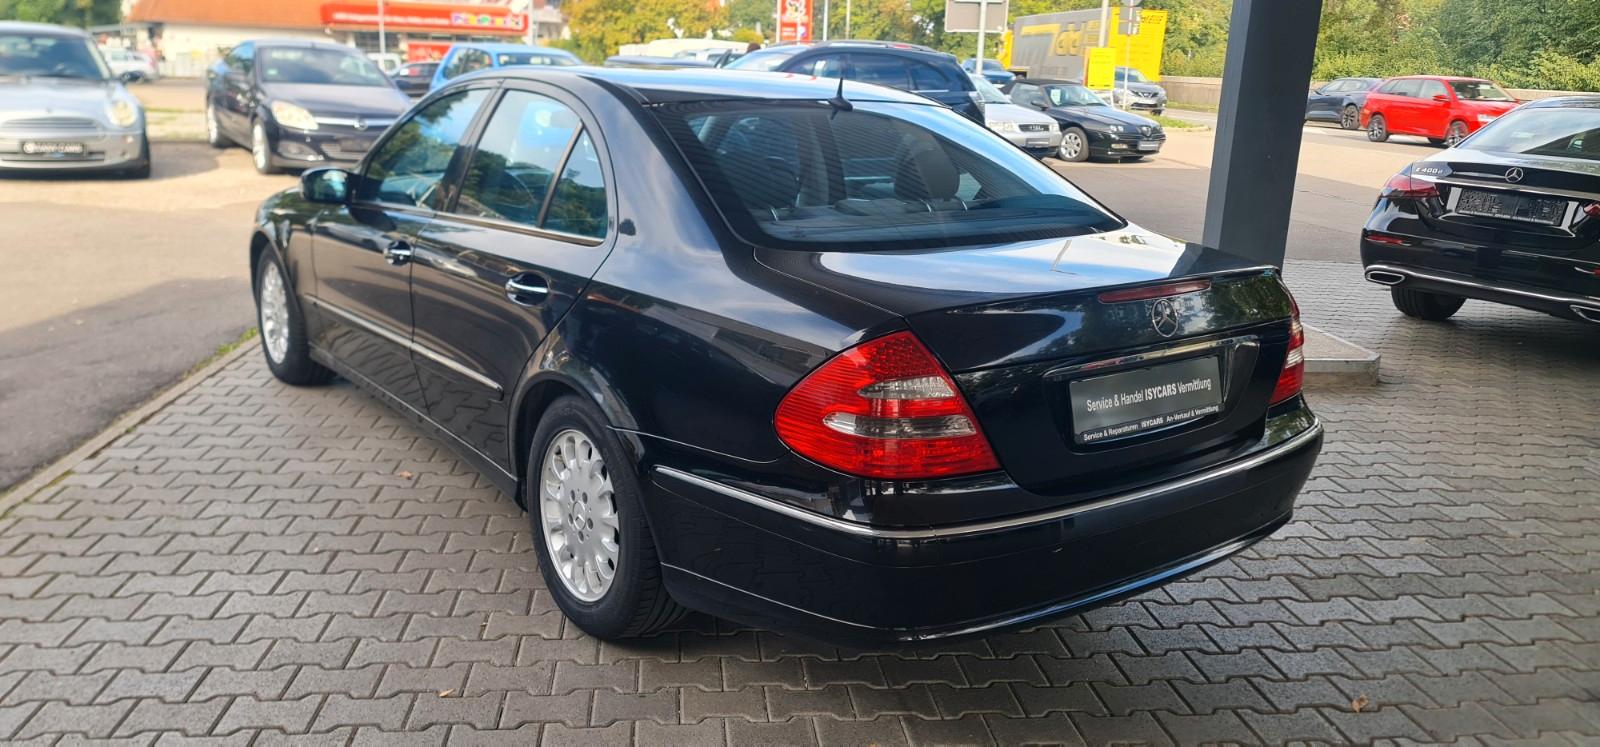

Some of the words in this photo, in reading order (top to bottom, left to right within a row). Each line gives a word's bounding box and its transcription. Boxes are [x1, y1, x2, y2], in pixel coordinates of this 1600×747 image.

[1086, 397, 1113, 412] Service
[1114, 394, 1120, 407] &
[1121, 390, 1144, 406] Handel
[1145, 383, 1177, 401] ISYCARS
[1177, 378, 1212, 394] Vermittlung
[1083, 432, 1103, 441] Service
[1103, 429, 1108, 437] &
[1108, 424, 1139, 436] Reparaturen
[1141, 417, 1164, 428] ISYCARS
[1166, 410, 1191, 422] An-Verkauf
[1191, 409, 1195, 417] &
[1195, 405, 1219, 416] Vermittlung
